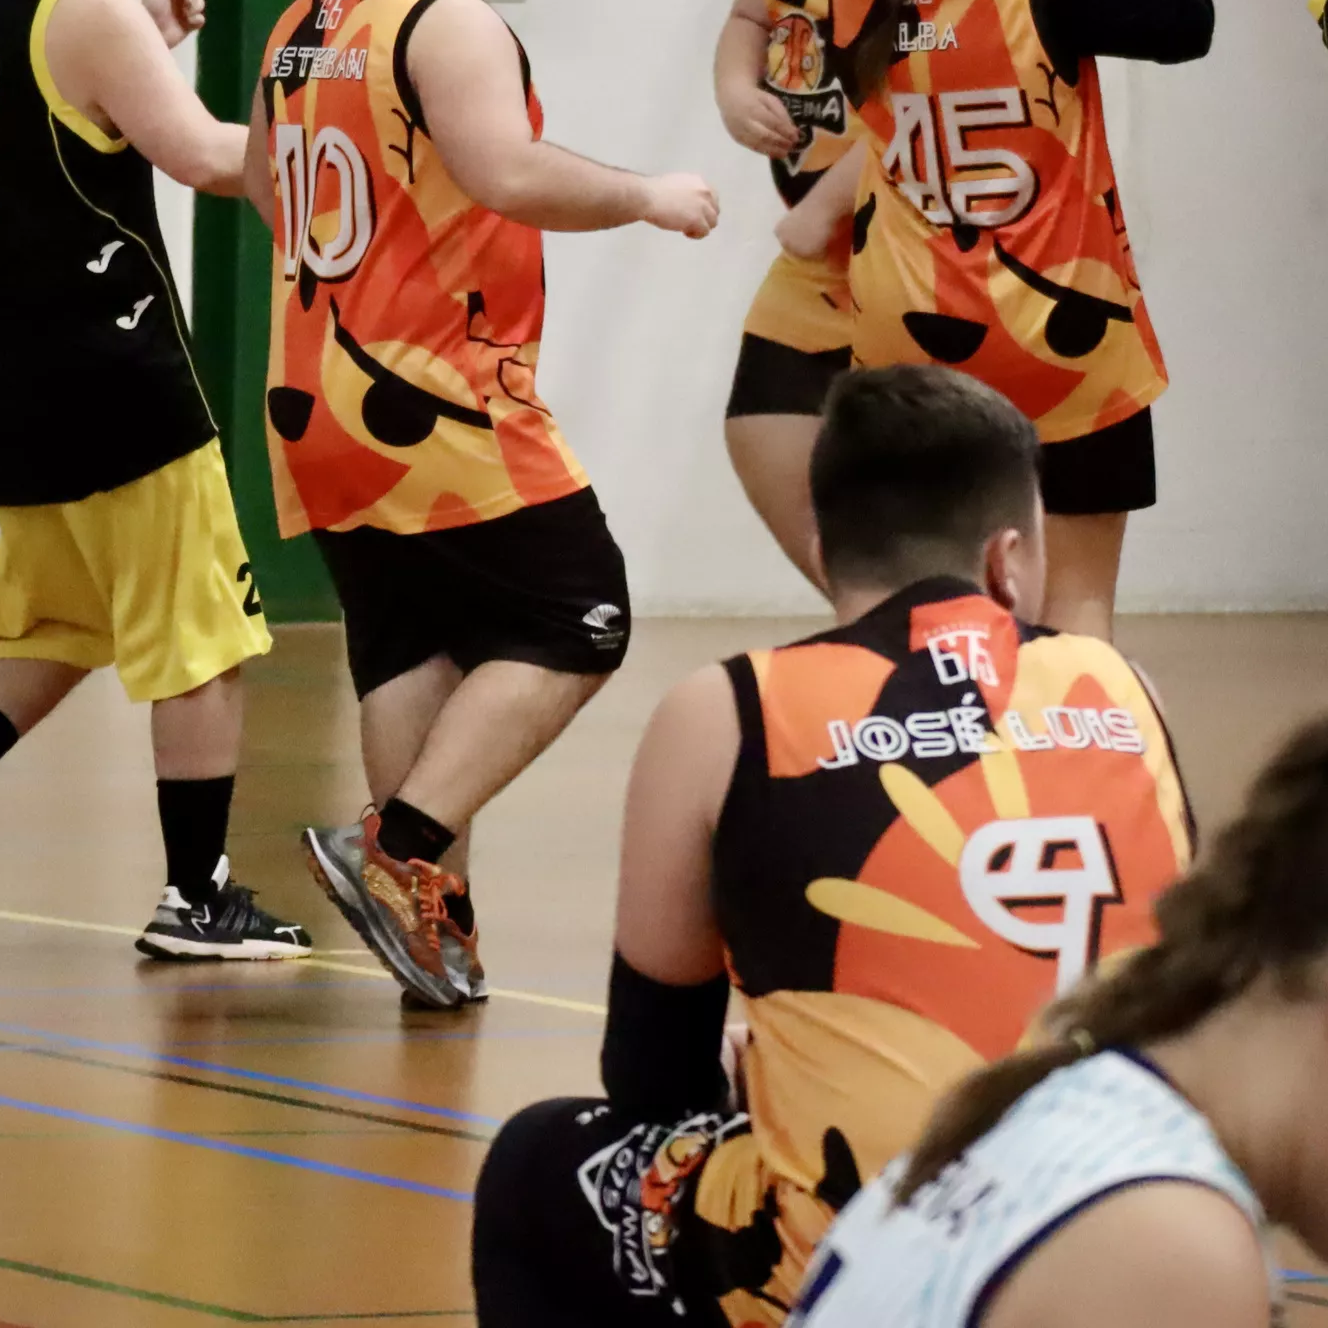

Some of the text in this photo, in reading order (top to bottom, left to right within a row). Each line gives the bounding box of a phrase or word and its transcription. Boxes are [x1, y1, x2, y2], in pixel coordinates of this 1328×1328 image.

[270, 46, 368, 80] ESTEBAN
[273, 123, 375, 281] 10
[817, 692, 1147, 770] JOSÉ LUIS
[959, 816, 1122, 1000] 9
